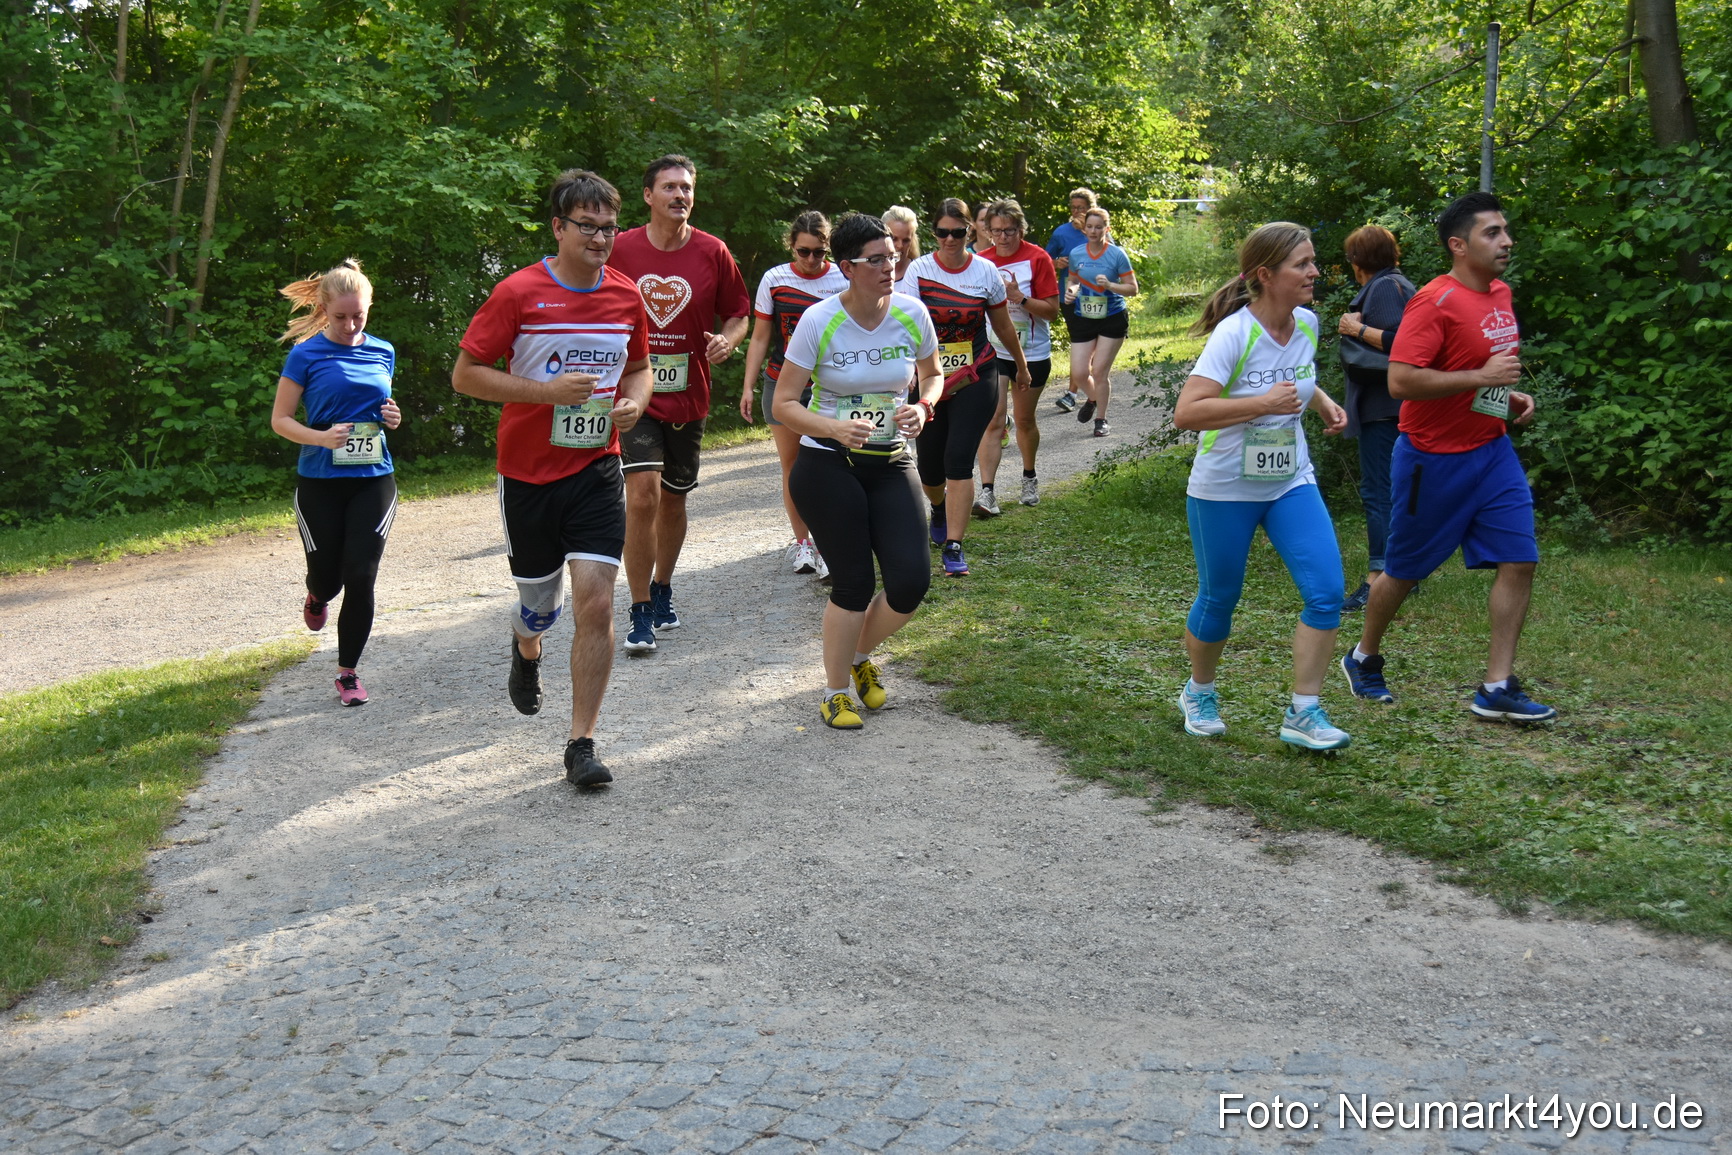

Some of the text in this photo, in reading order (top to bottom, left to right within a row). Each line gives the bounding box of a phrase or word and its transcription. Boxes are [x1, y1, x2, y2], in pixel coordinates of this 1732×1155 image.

[650, 291, 676, 301] Albert
[1082, 303, 1104, 313] 1917
[562, 415, 606, 434] 1810
[345, 438, 373, 453] 575
[1256, 450, 1291, 469] 9104
